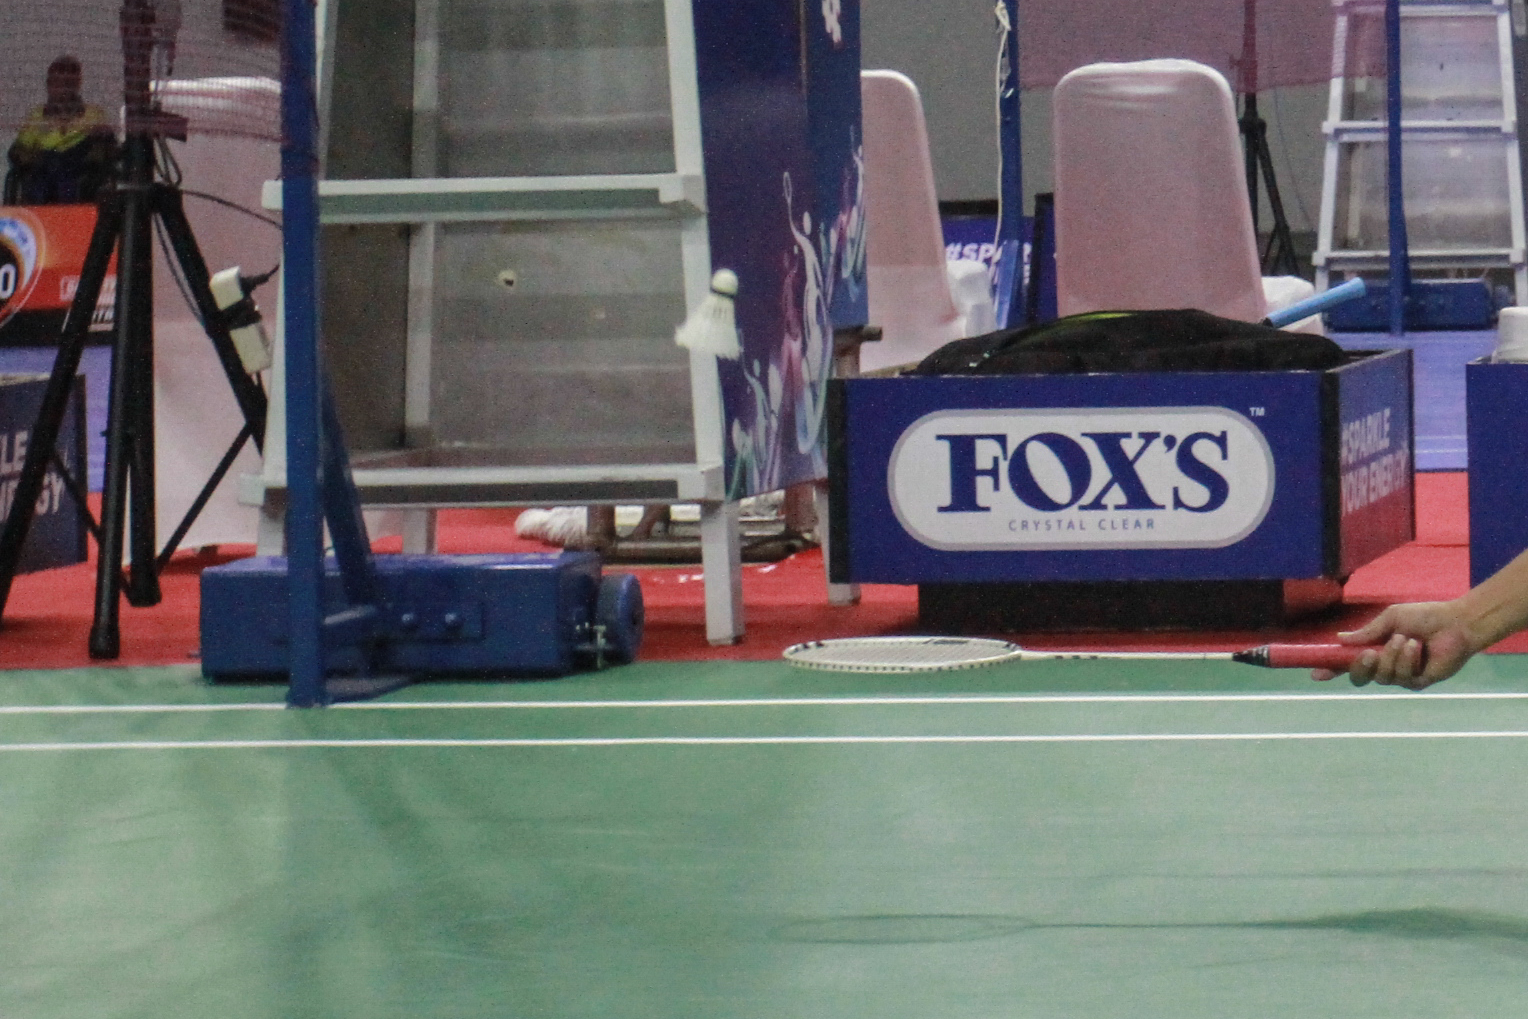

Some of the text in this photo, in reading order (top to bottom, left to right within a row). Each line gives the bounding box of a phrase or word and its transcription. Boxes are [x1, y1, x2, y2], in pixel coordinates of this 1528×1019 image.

[1249, 407, 1266, 418] TM
[935, 430, 1230, 513] FOX'S
[1008, 518, 1155, 531] CRYSTAL CLEAR
